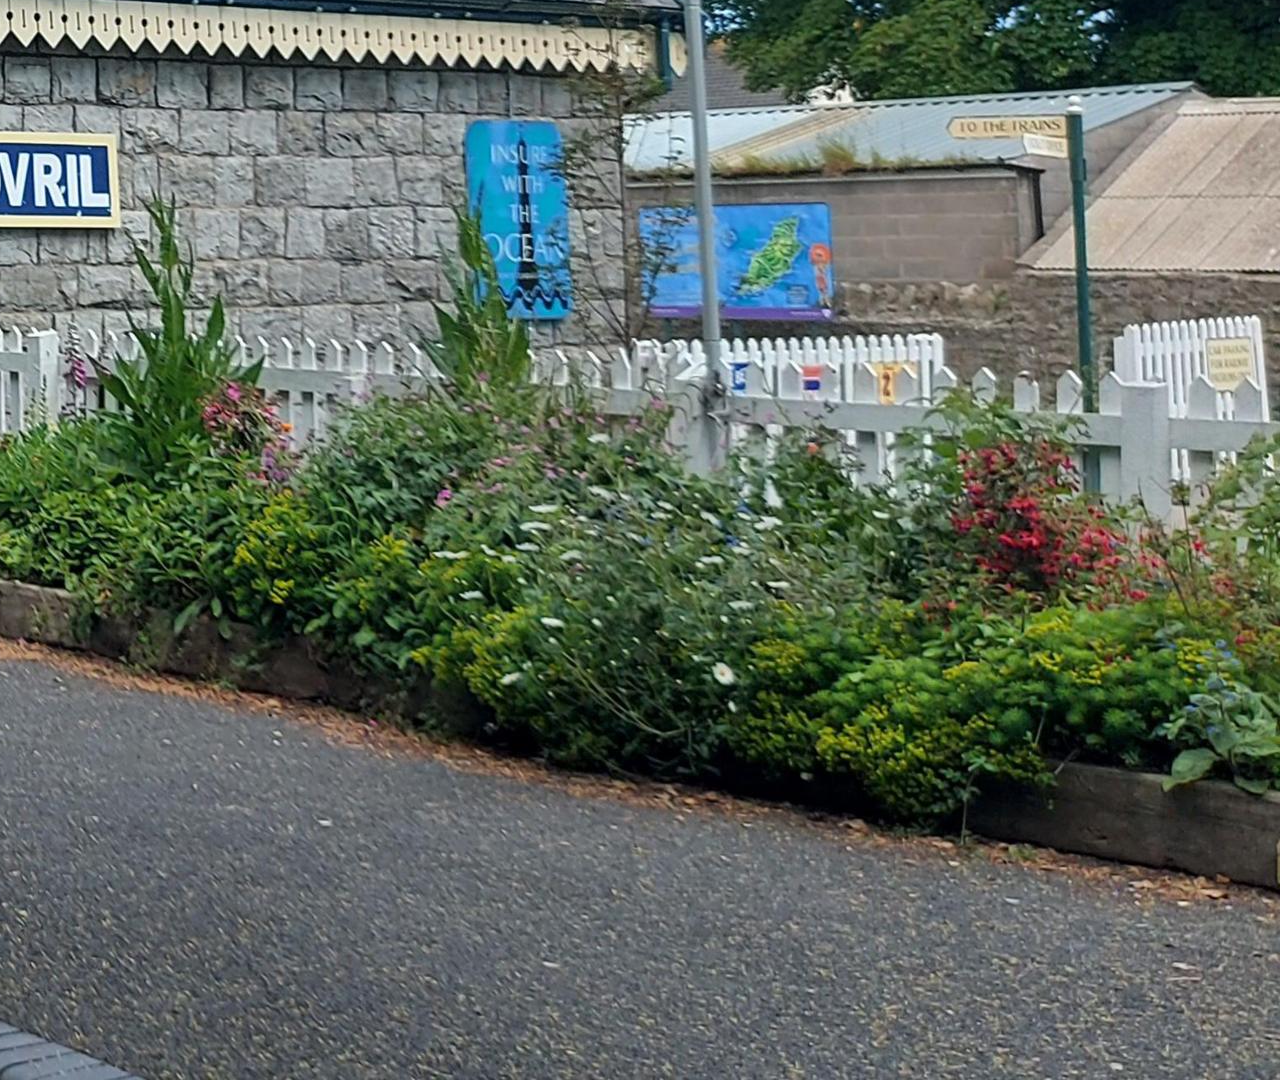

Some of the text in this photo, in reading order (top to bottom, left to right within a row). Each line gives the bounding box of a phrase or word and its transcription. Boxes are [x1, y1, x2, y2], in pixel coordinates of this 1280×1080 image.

[960, 122, 977, 133] TO
[1012, 119, 1061, 133] TRAINS
[491, 144, 547, 164] INSURE
[502, 175, 544, 193] WITH
[509, 204, 540, 223] THE
[482, 233, 565, 263] OCEAN
